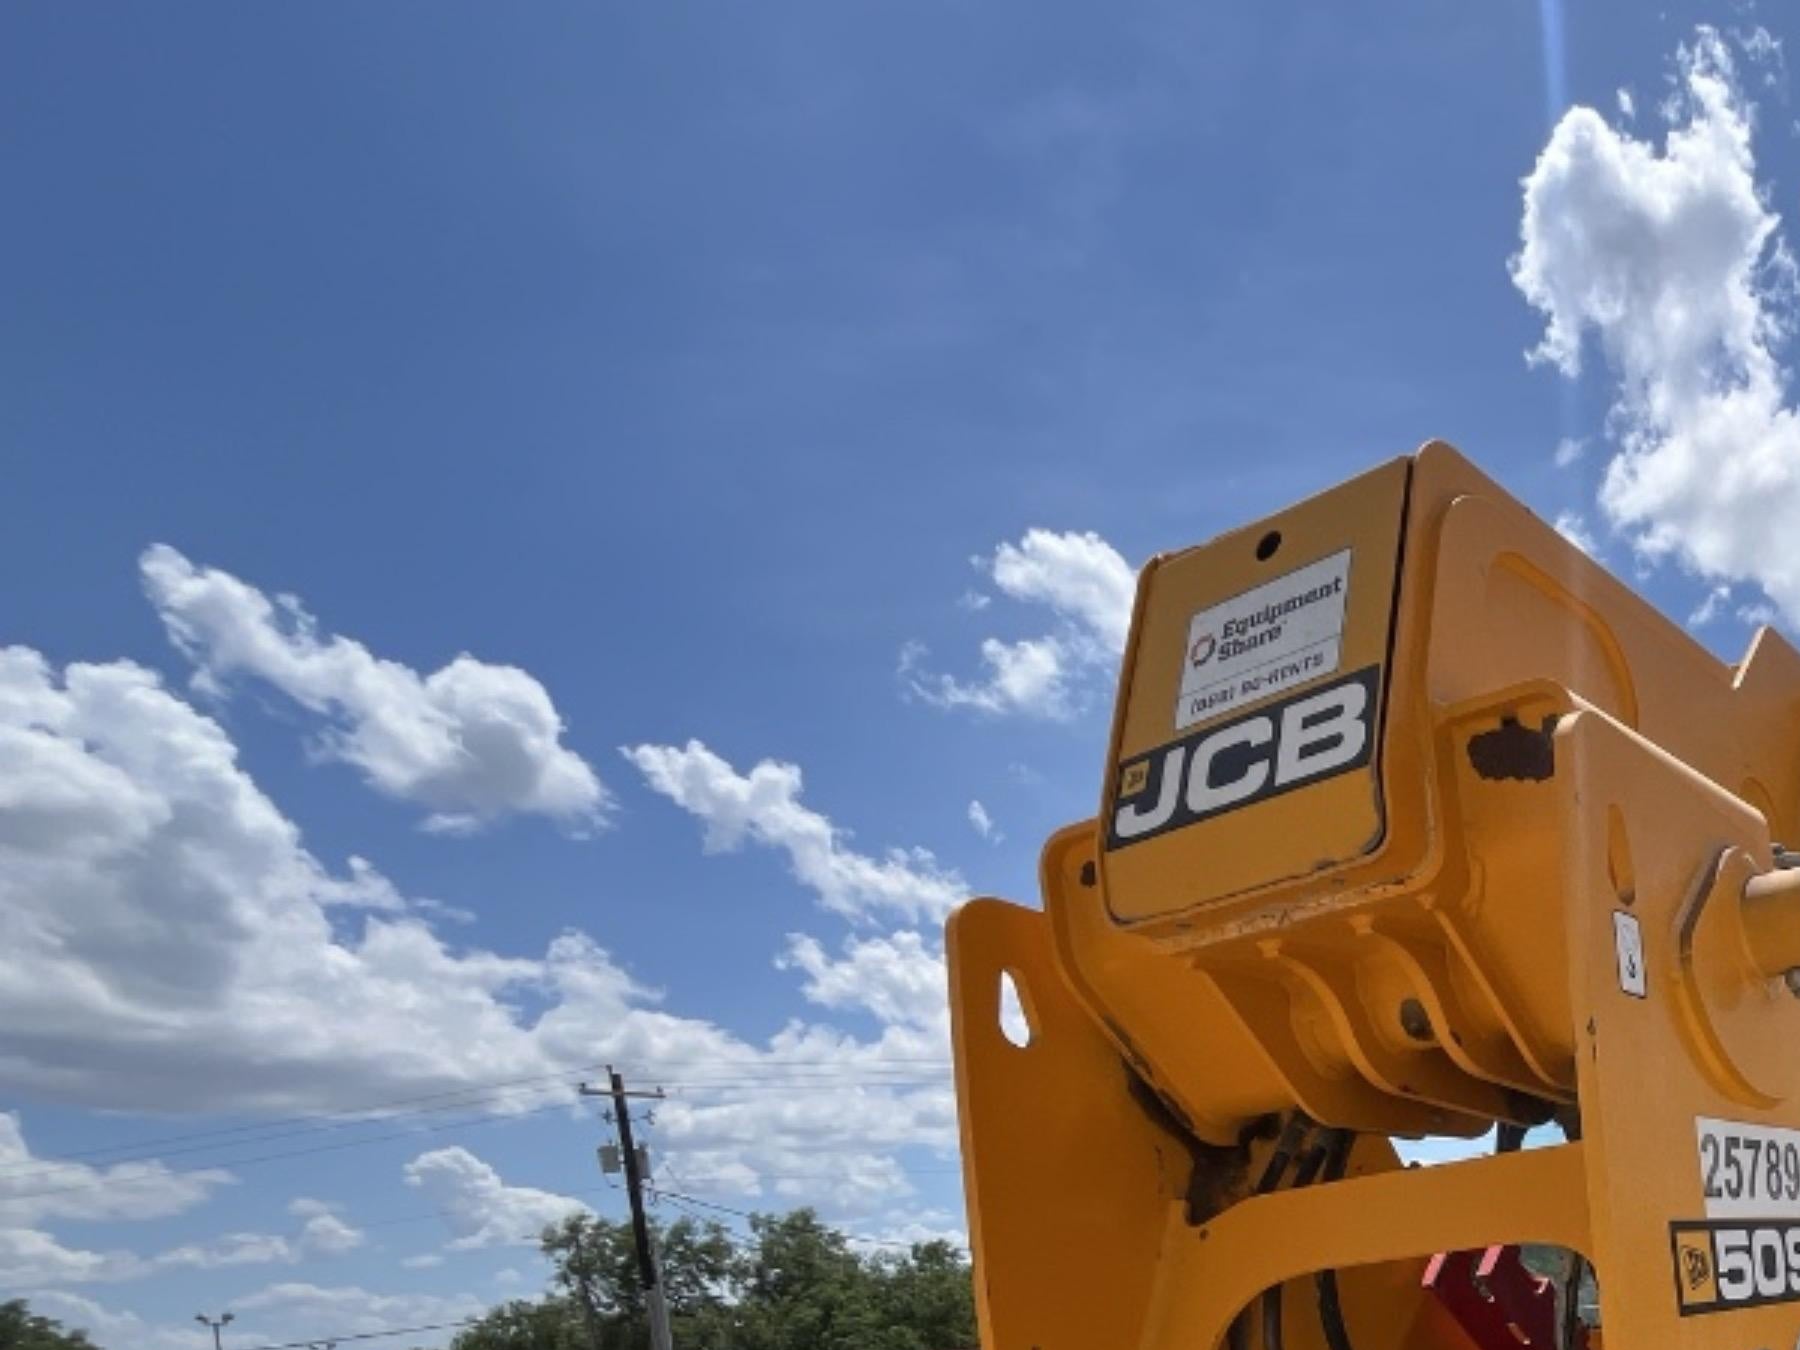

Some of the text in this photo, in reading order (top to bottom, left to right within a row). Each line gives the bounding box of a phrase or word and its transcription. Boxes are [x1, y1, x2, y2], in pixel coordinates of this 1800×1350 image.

[1221, 576, 1342, 639] Equipment
[1217, 625, 1283, 662] Share
[1115, 682, 1367, 838] JCB
